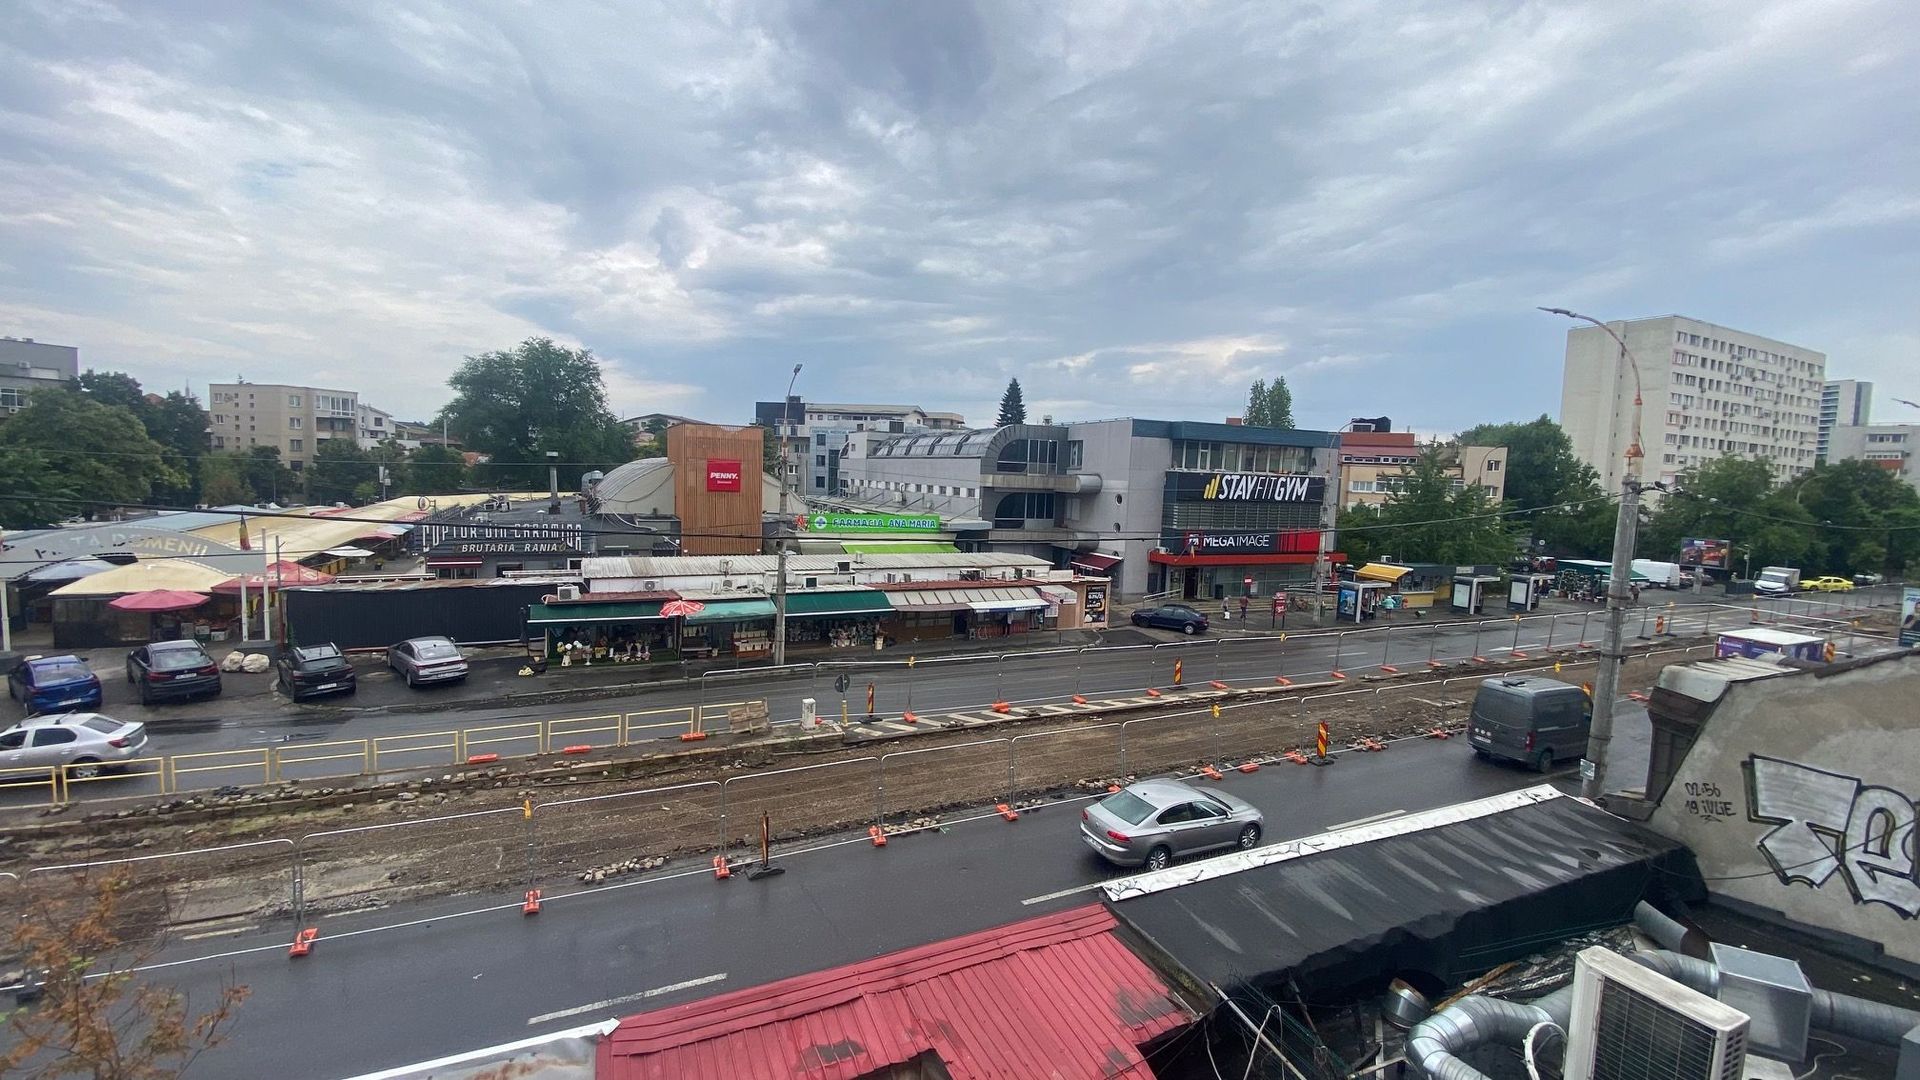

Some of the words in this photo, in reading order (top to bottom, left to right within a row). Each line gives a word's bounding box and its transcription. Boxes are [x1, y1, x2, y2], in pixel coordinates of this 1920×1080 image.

[832, 518, 884, 528] FARMACIA
[889, 518, 908, 528] ANA
[909, 519, 936, 529] MARIA
[462, 543, 515, 552] BRUTARIA
[524, 543, 558, 552] RANIA
[1685, 782, 1721, 797] 02:56
[1685, 800, 1700, 815] 19
